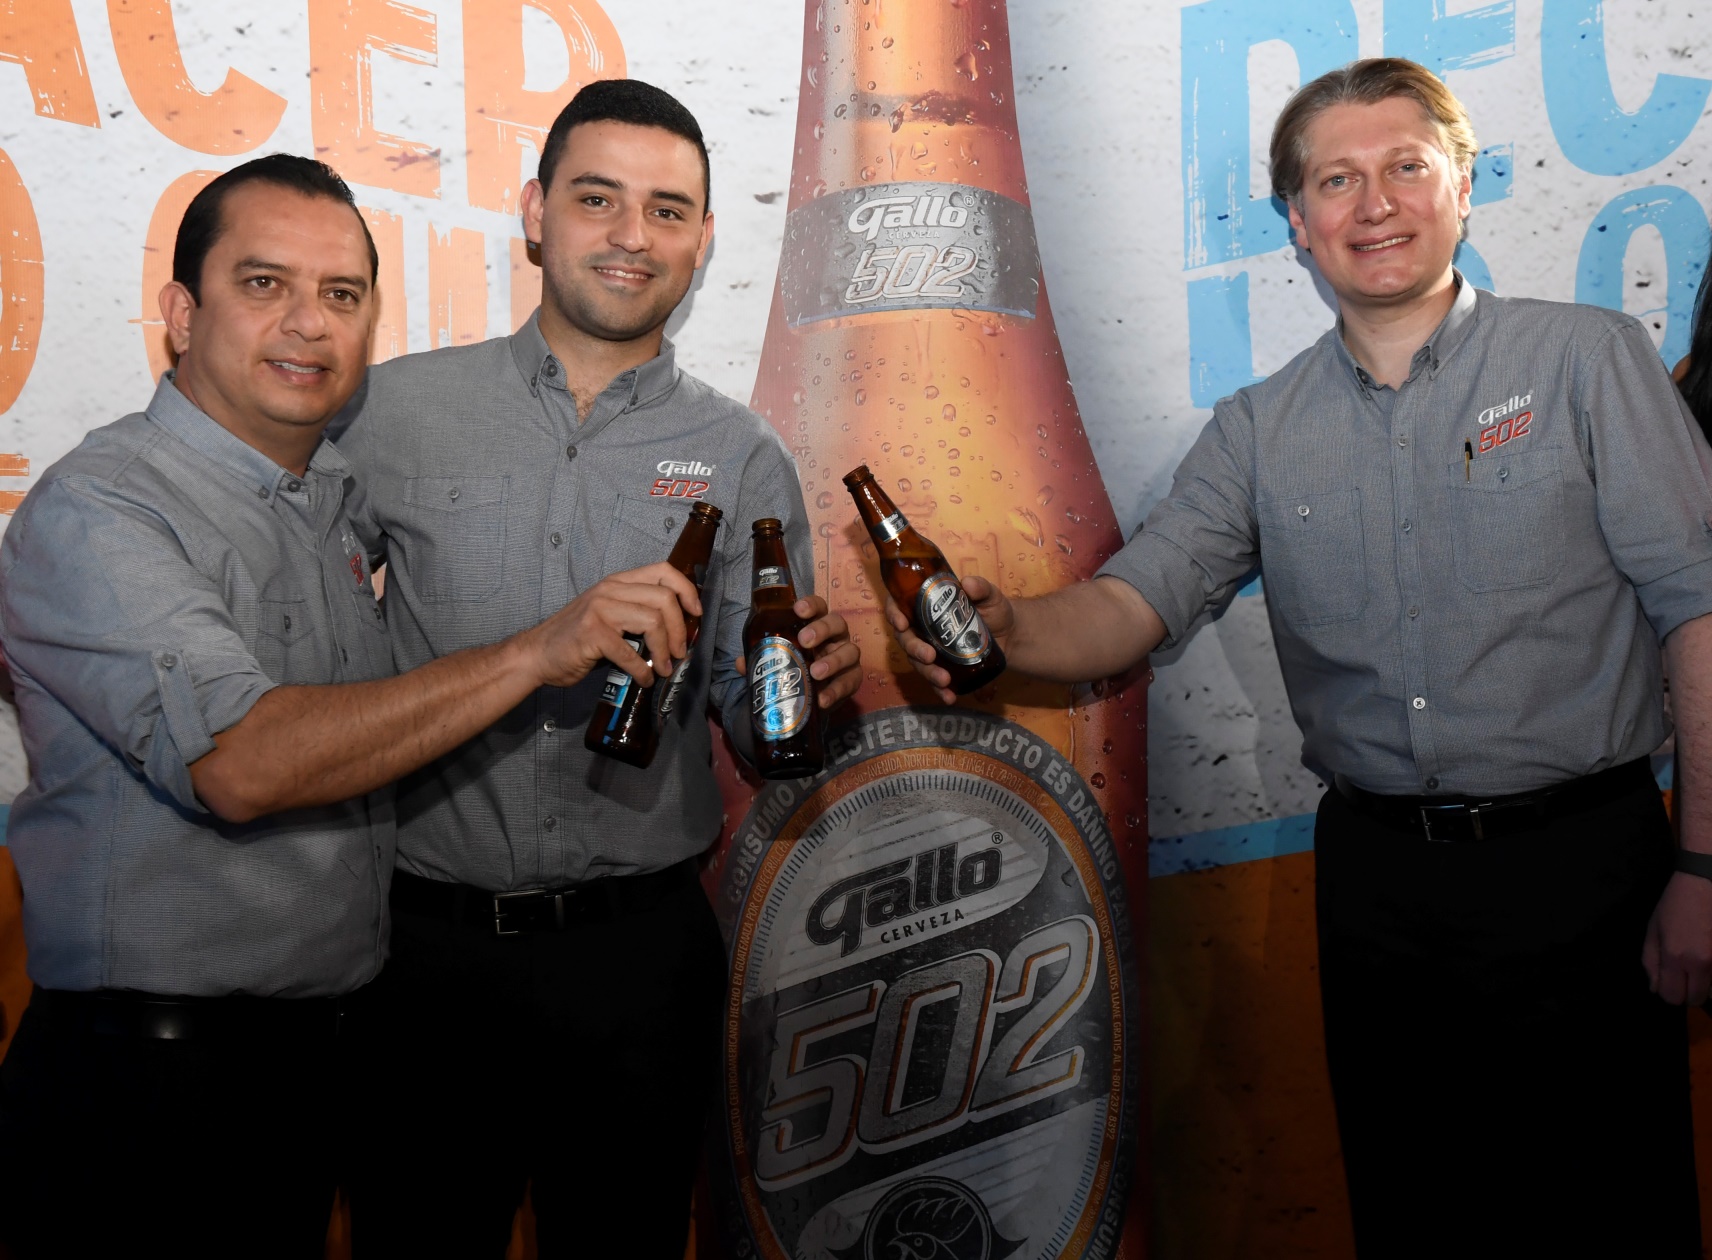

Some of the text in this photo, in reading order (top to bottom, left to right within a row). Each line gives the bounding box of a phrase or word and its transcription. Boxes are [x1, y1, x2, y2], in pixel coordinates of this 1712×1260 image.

[848, 196, 968, 241] Gallo
[845, 245, 978, 304] 502
[1478, 394, 1531, 425] Gallo
[1478, 411, 1533, 454] 502
[657, 461, 712, 477] Gallo
[649, 478, 710, 500] 502
[932, 587, 953, 613] Gallo
[940, 589, 974, 647] 502
[755, 657, 784, 676] Gallo
[753, 667, 802, 715] 502
[867, 757, 901, 778] AVENIDA
[904, 753, 931, 769] NORTE
[727, 783, 795, 901] CONSUMO
[828, 718, 896, 766] ESTE
[902, 714, 1043, 769] PRODUCTO
[1042, 758, 1072, 795] ES
[806, 842, 1003, 957] Gallo
[1088, 881, 1098, 894] DE
[745, 902, 760, 923] POR
[880, 908, 965, 943] CERVEZA
[1094, 894, 1111, 938] NUESTROS
[734, 921, 754, 974] GUATEMALA
[1104, 938, 1119, 990] PRODUCTOS
[734, 973, 743, 986] EN
[730, 988, 742, 1020] HECHO
[1111, 991, 1122, 1020] LLAME
[754, 913, 1101, 1193] 502
[1112, 1021, 1123, 1055] GRATIS
[1113, 1055, 1123, 1067] AL
[728, 1107, 745, 1155] PRODUCTO
[1106, 1114, 1118, 1140] 8392
